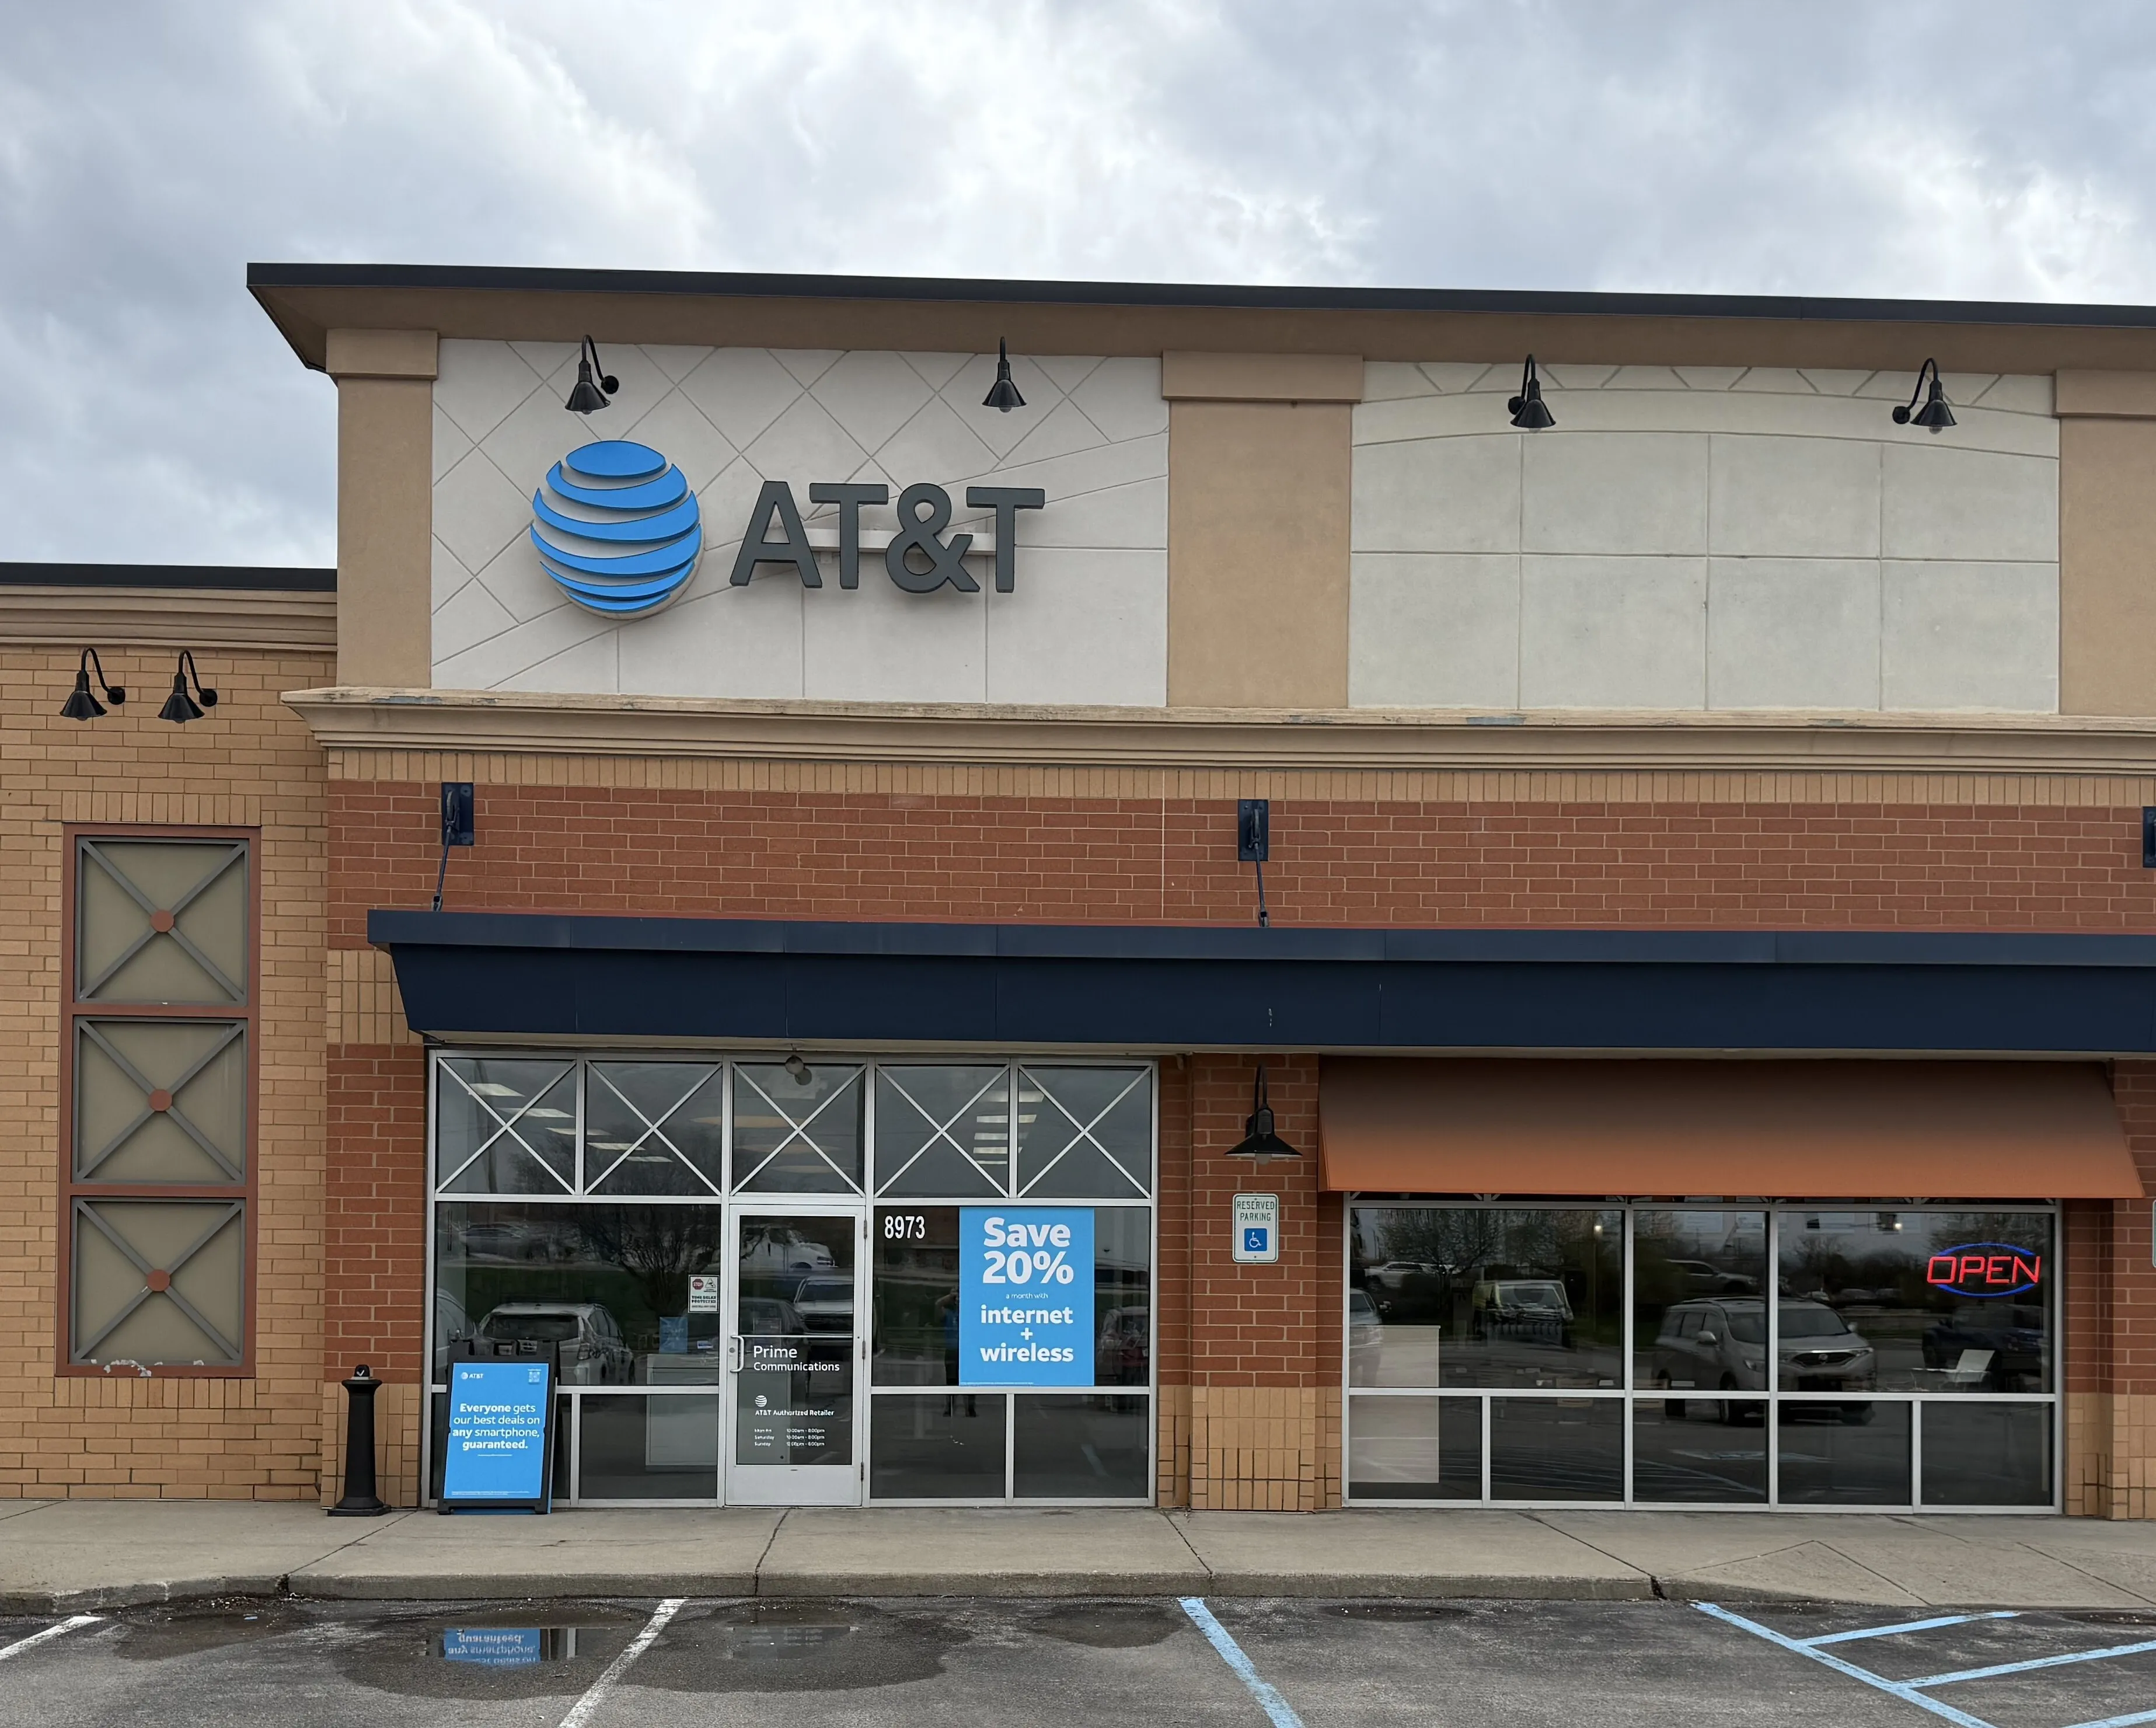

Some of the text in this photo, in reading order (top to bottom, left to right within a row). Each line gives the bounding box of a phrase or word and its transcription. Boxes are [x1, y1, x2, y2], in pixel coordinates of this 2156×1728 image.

[730, 480, 1045, 593] AT&T
[1237, 1201, 1274, 1210] RESERVED
[1240, 1213, 1271, 1221] PARKING
[884, 1215, 925, 1239] 8973
[983, 1217, 1070, 1248] Save
[982, 1250, 1074, 1284] 20%
[1927, 1256, 2040, 1284] OPEN
[981, 1305, 1073, 1324] internet
[753, 1345, 798, 1358] Prime
[980, 1343, 1074, 1362] wireless
[753, 1361, 840, 1371] Communications
[460, 1403, 536, 1415] Everyone gets
[473, 1415, 496, 1424] best
[498, 1415, 525, 1424] deals
[452, 1427, 540, 1438] any smartphone,
[462, 1439, 528, 1451] guaranteed.
